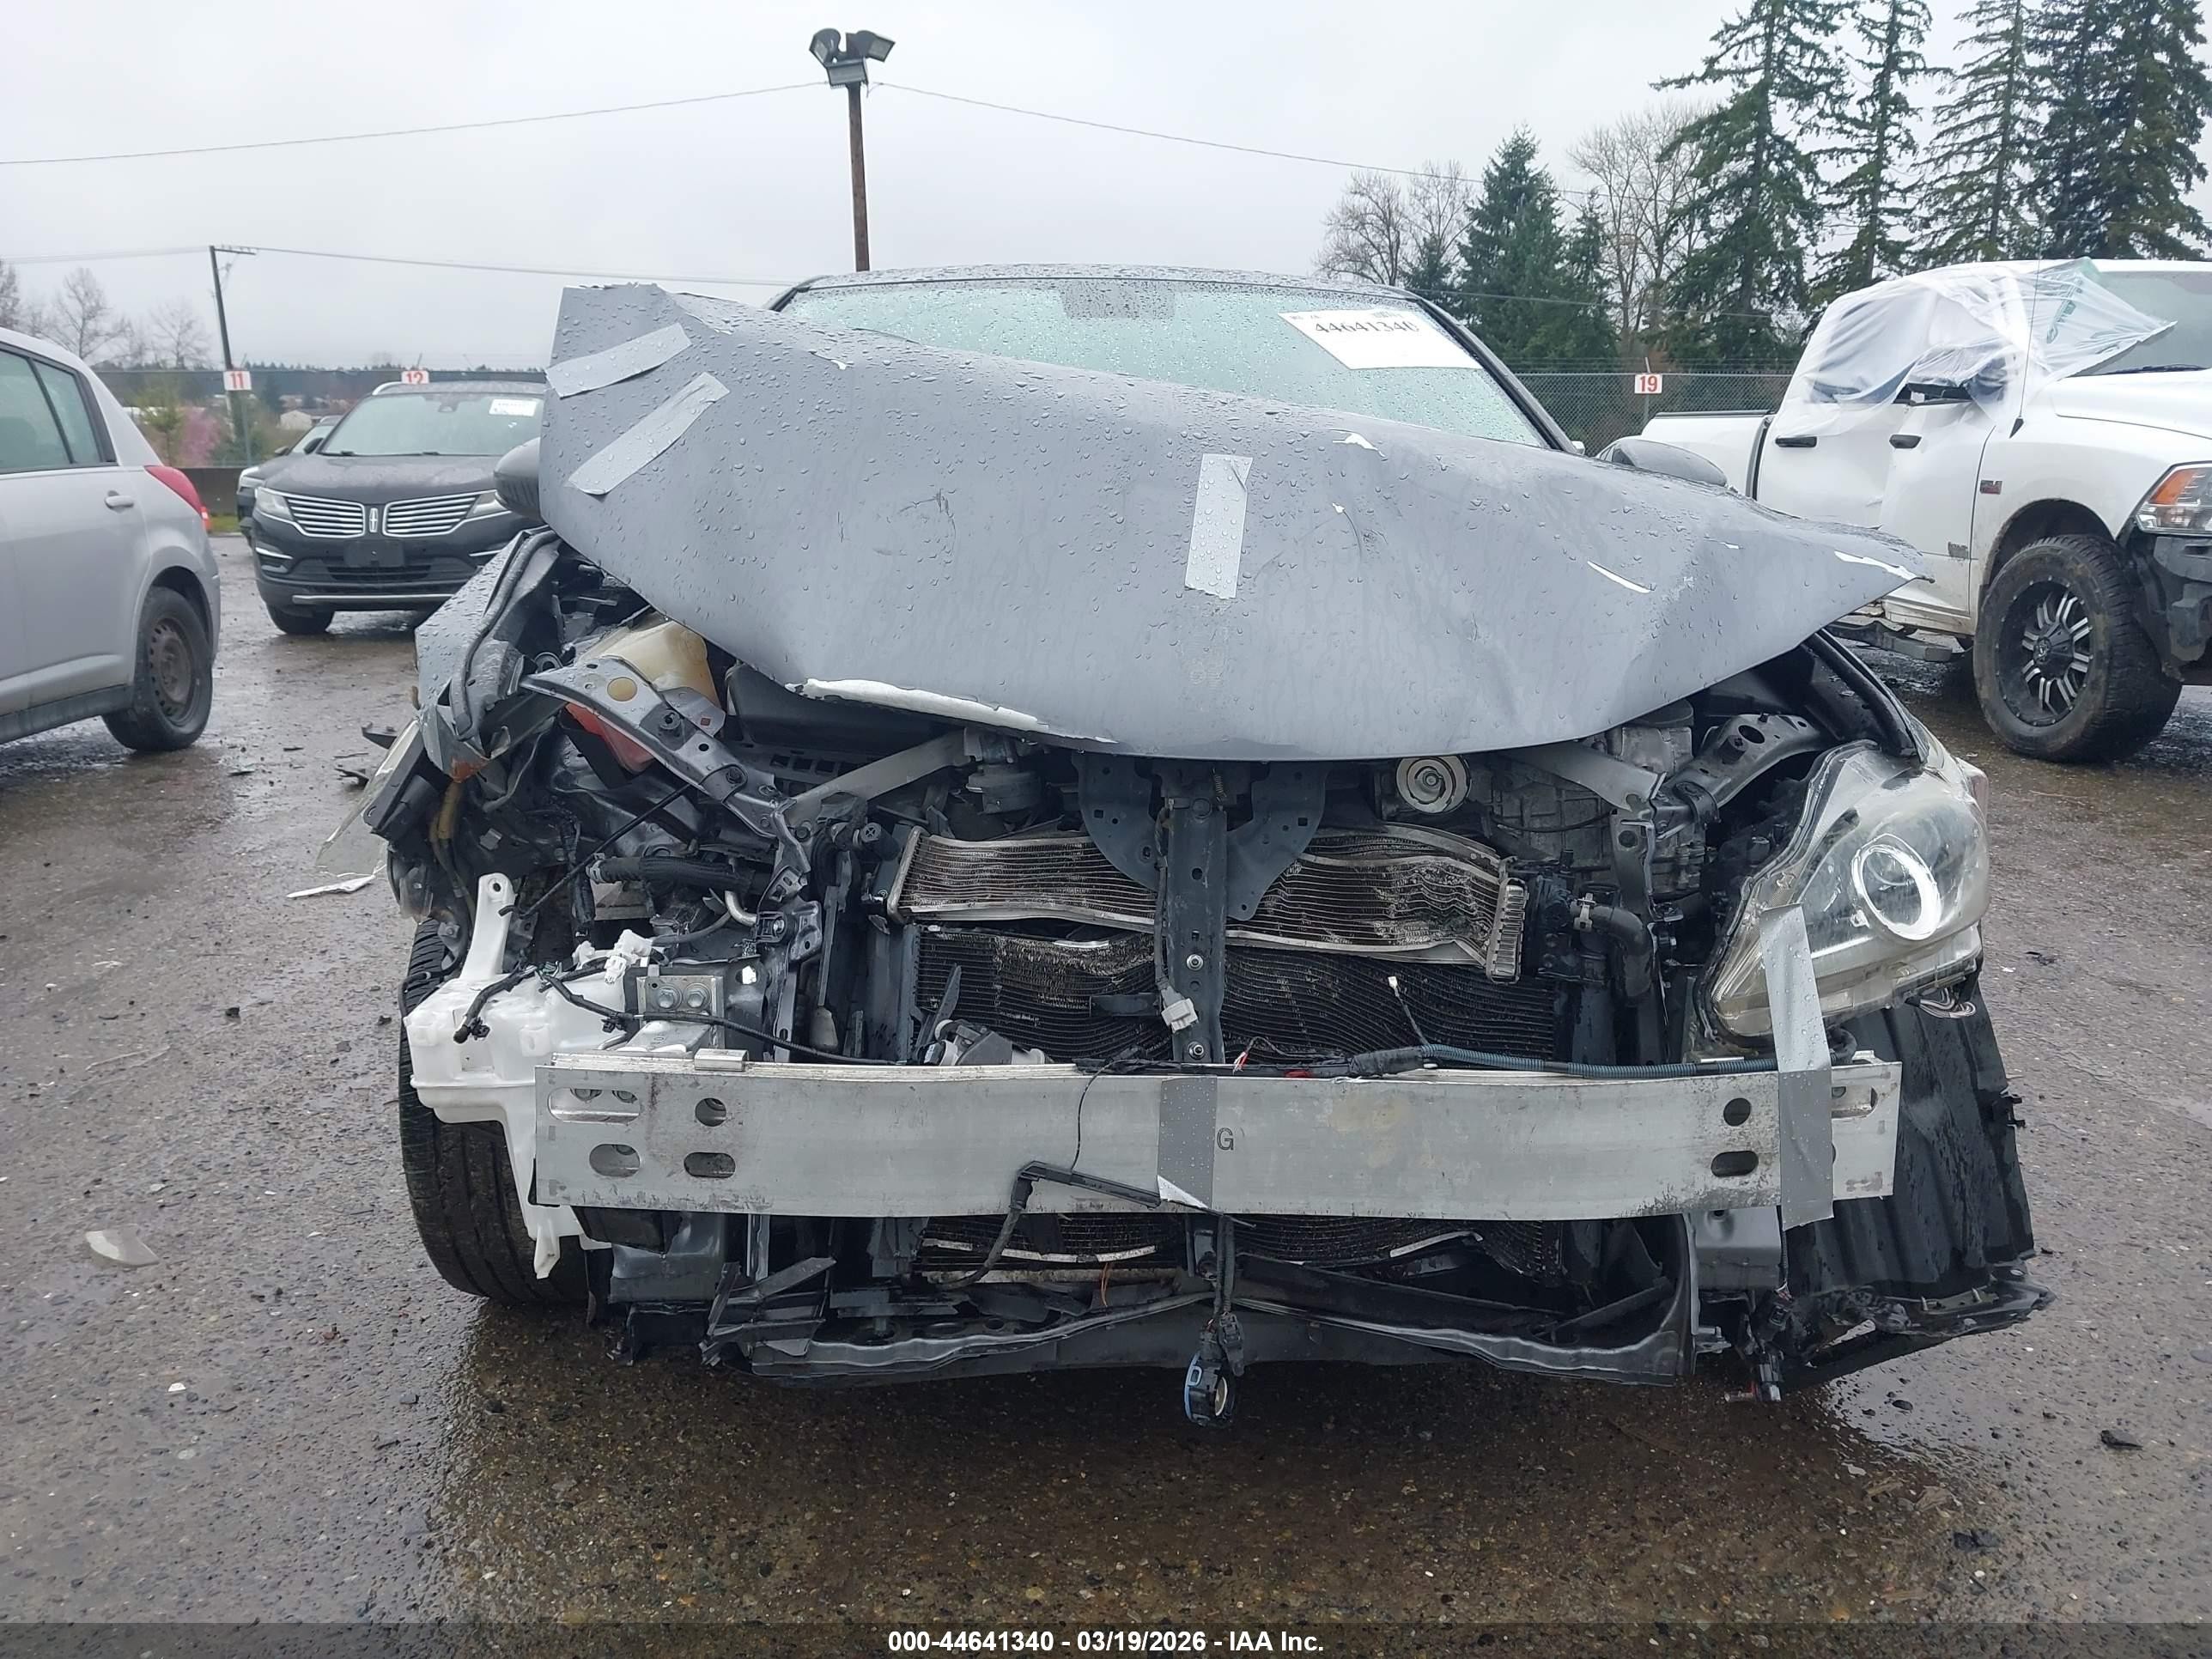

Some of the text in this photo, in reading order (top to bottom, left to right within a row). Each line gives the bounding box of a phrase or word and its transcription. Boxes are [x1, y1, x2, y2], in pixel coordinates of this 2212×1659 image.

[230, 373, 244, 389] 11
[406, 372, 423, 384] 12
[1640, 375, 1657, 392] 19
[1216, 1127, 1234, 1151] G
